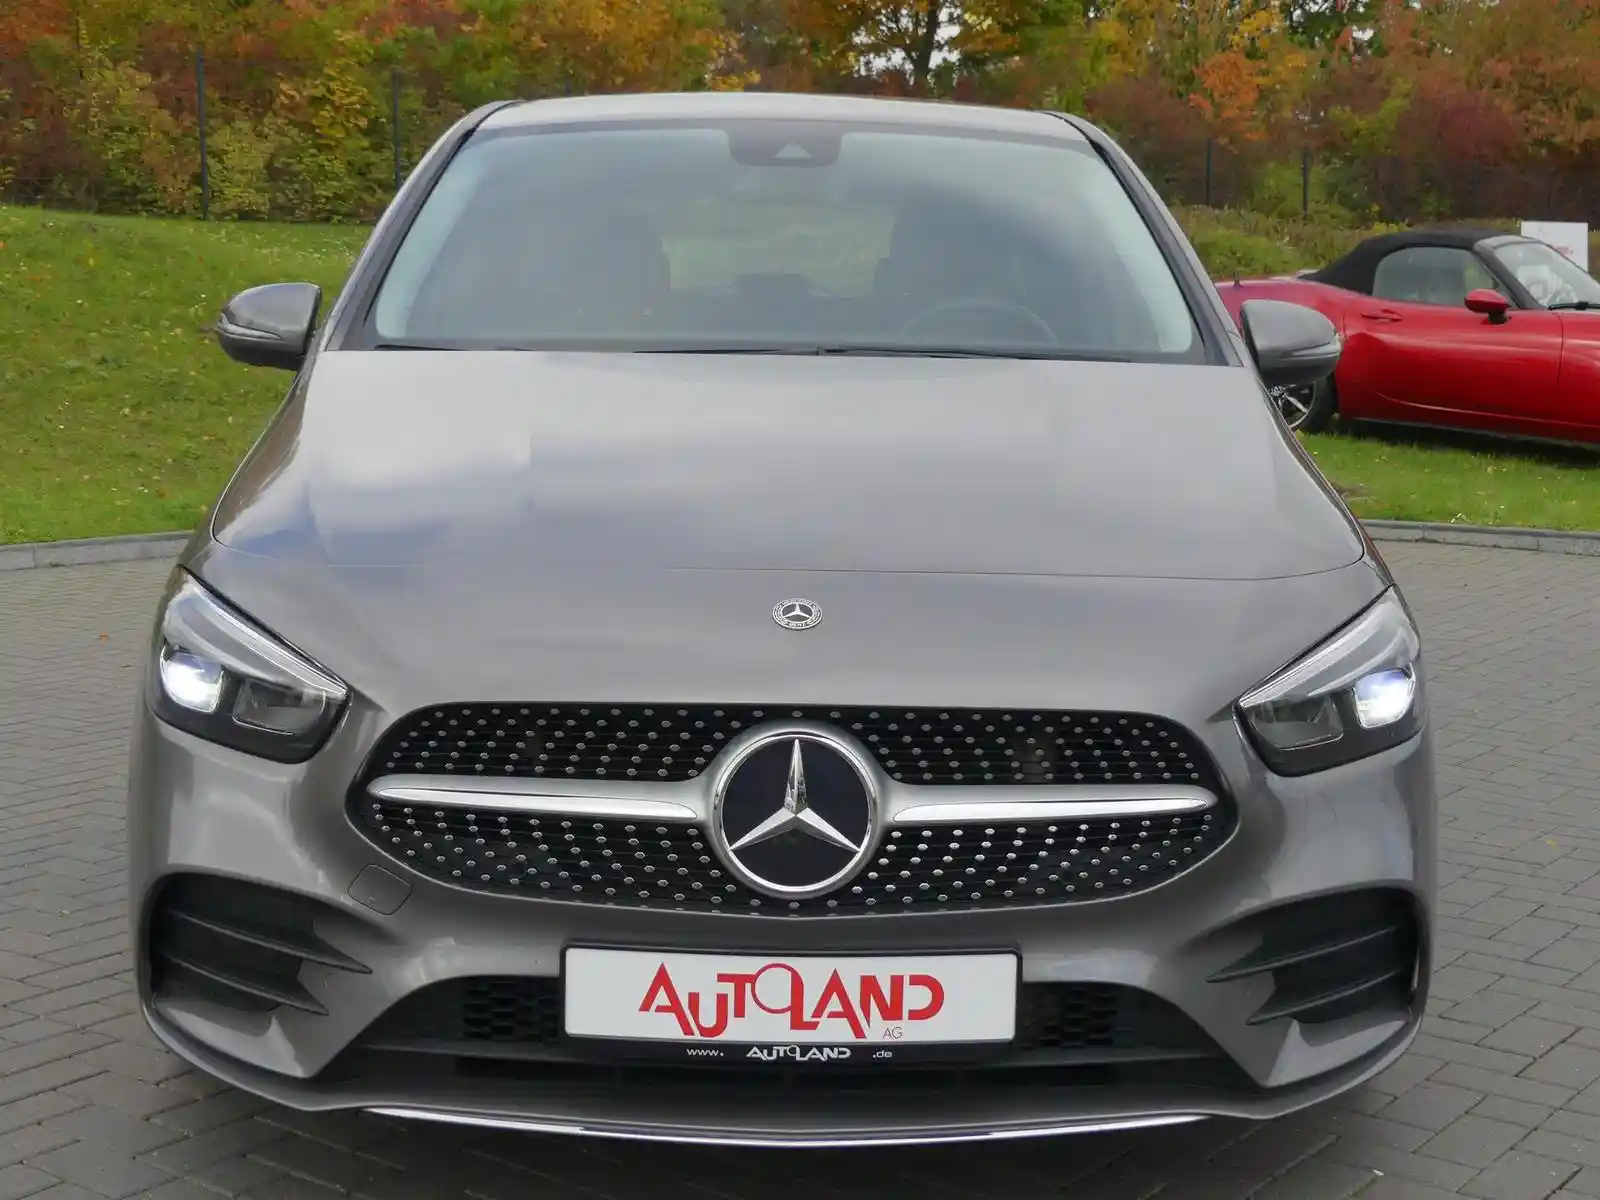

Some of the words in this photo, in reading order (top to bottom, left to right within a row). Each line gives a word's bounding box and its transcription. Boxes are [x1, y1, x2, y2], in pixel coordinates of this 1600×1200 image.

[639, 963, 945, 1039] AUTOLAND
[882, 1027, 904, 1039] AG
[686, 1048, 724, 1057] www.
[746, 1045, 852, 1061] AUTOLAND
[872, 1048, 893, 1059] .de
